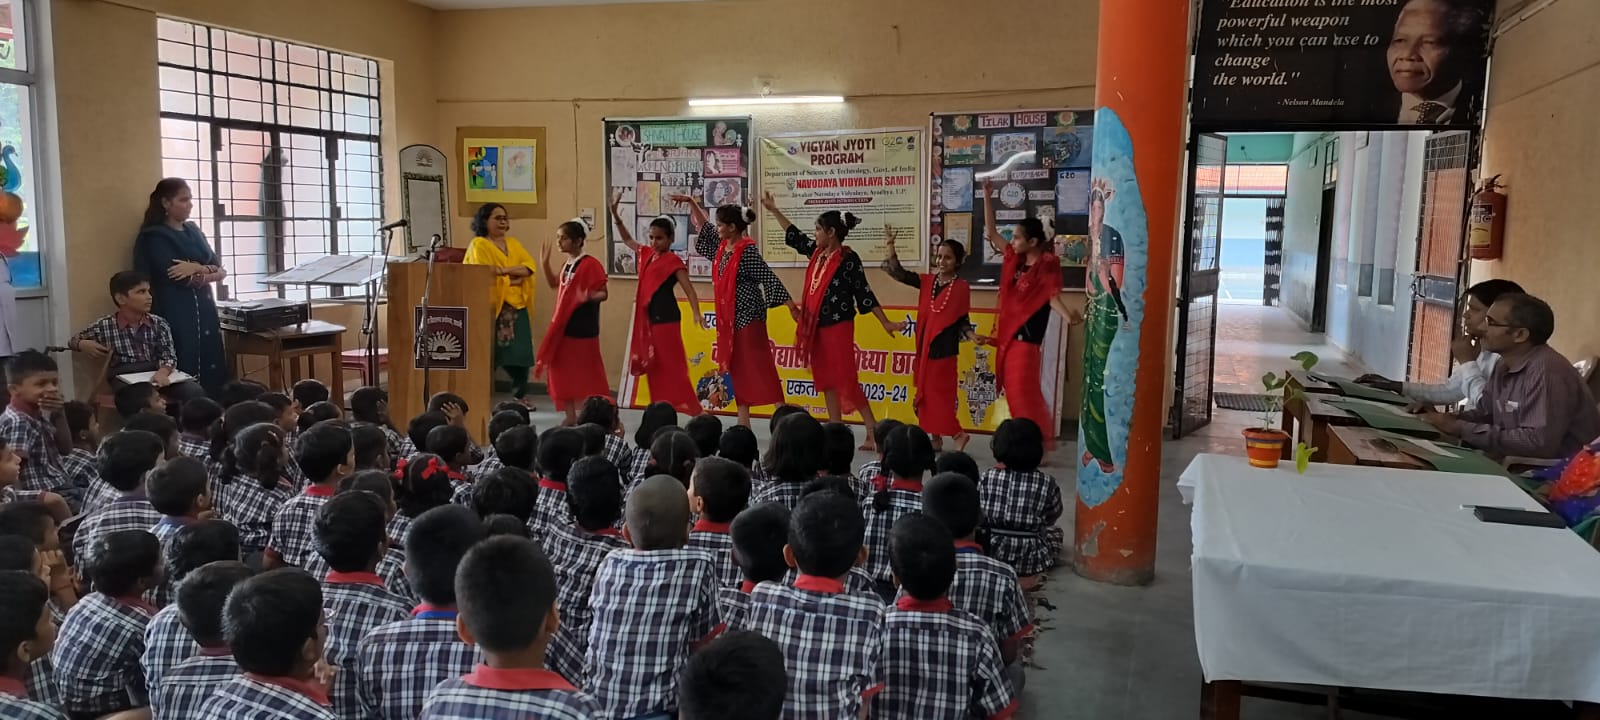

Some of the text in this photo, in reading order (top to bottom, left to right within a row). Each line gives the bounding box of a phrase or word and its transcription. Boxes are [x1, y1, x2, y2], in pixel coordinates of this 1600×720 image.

[1216, 13, 1350, 31] powerful weapon
[1217, 34, 1379, 50] which you can use to
[1215, 53, 1270, 69] change
[1213, 72, 1237, 86] the
[1282, 98, 1309, 107] Nelson
[1310, 98, 1345, 107] Mandela
[981, 112, 1047, 127] TILAK HOUSE
[800, 140, 839, 152] VIGYAN
[843, 138, 876, 150] JYOTI
[811, 152, 864, 166] PROGRAM
[764, 170, 798, 178] Department
[837, 167, 871, 176] Technology,
[873, 166, 889, 174] Govt.
[1060, 171, 1076, 179] G20
[796, 175, 916, 189] NAVODAYA VIDYALAYA SAMITI
